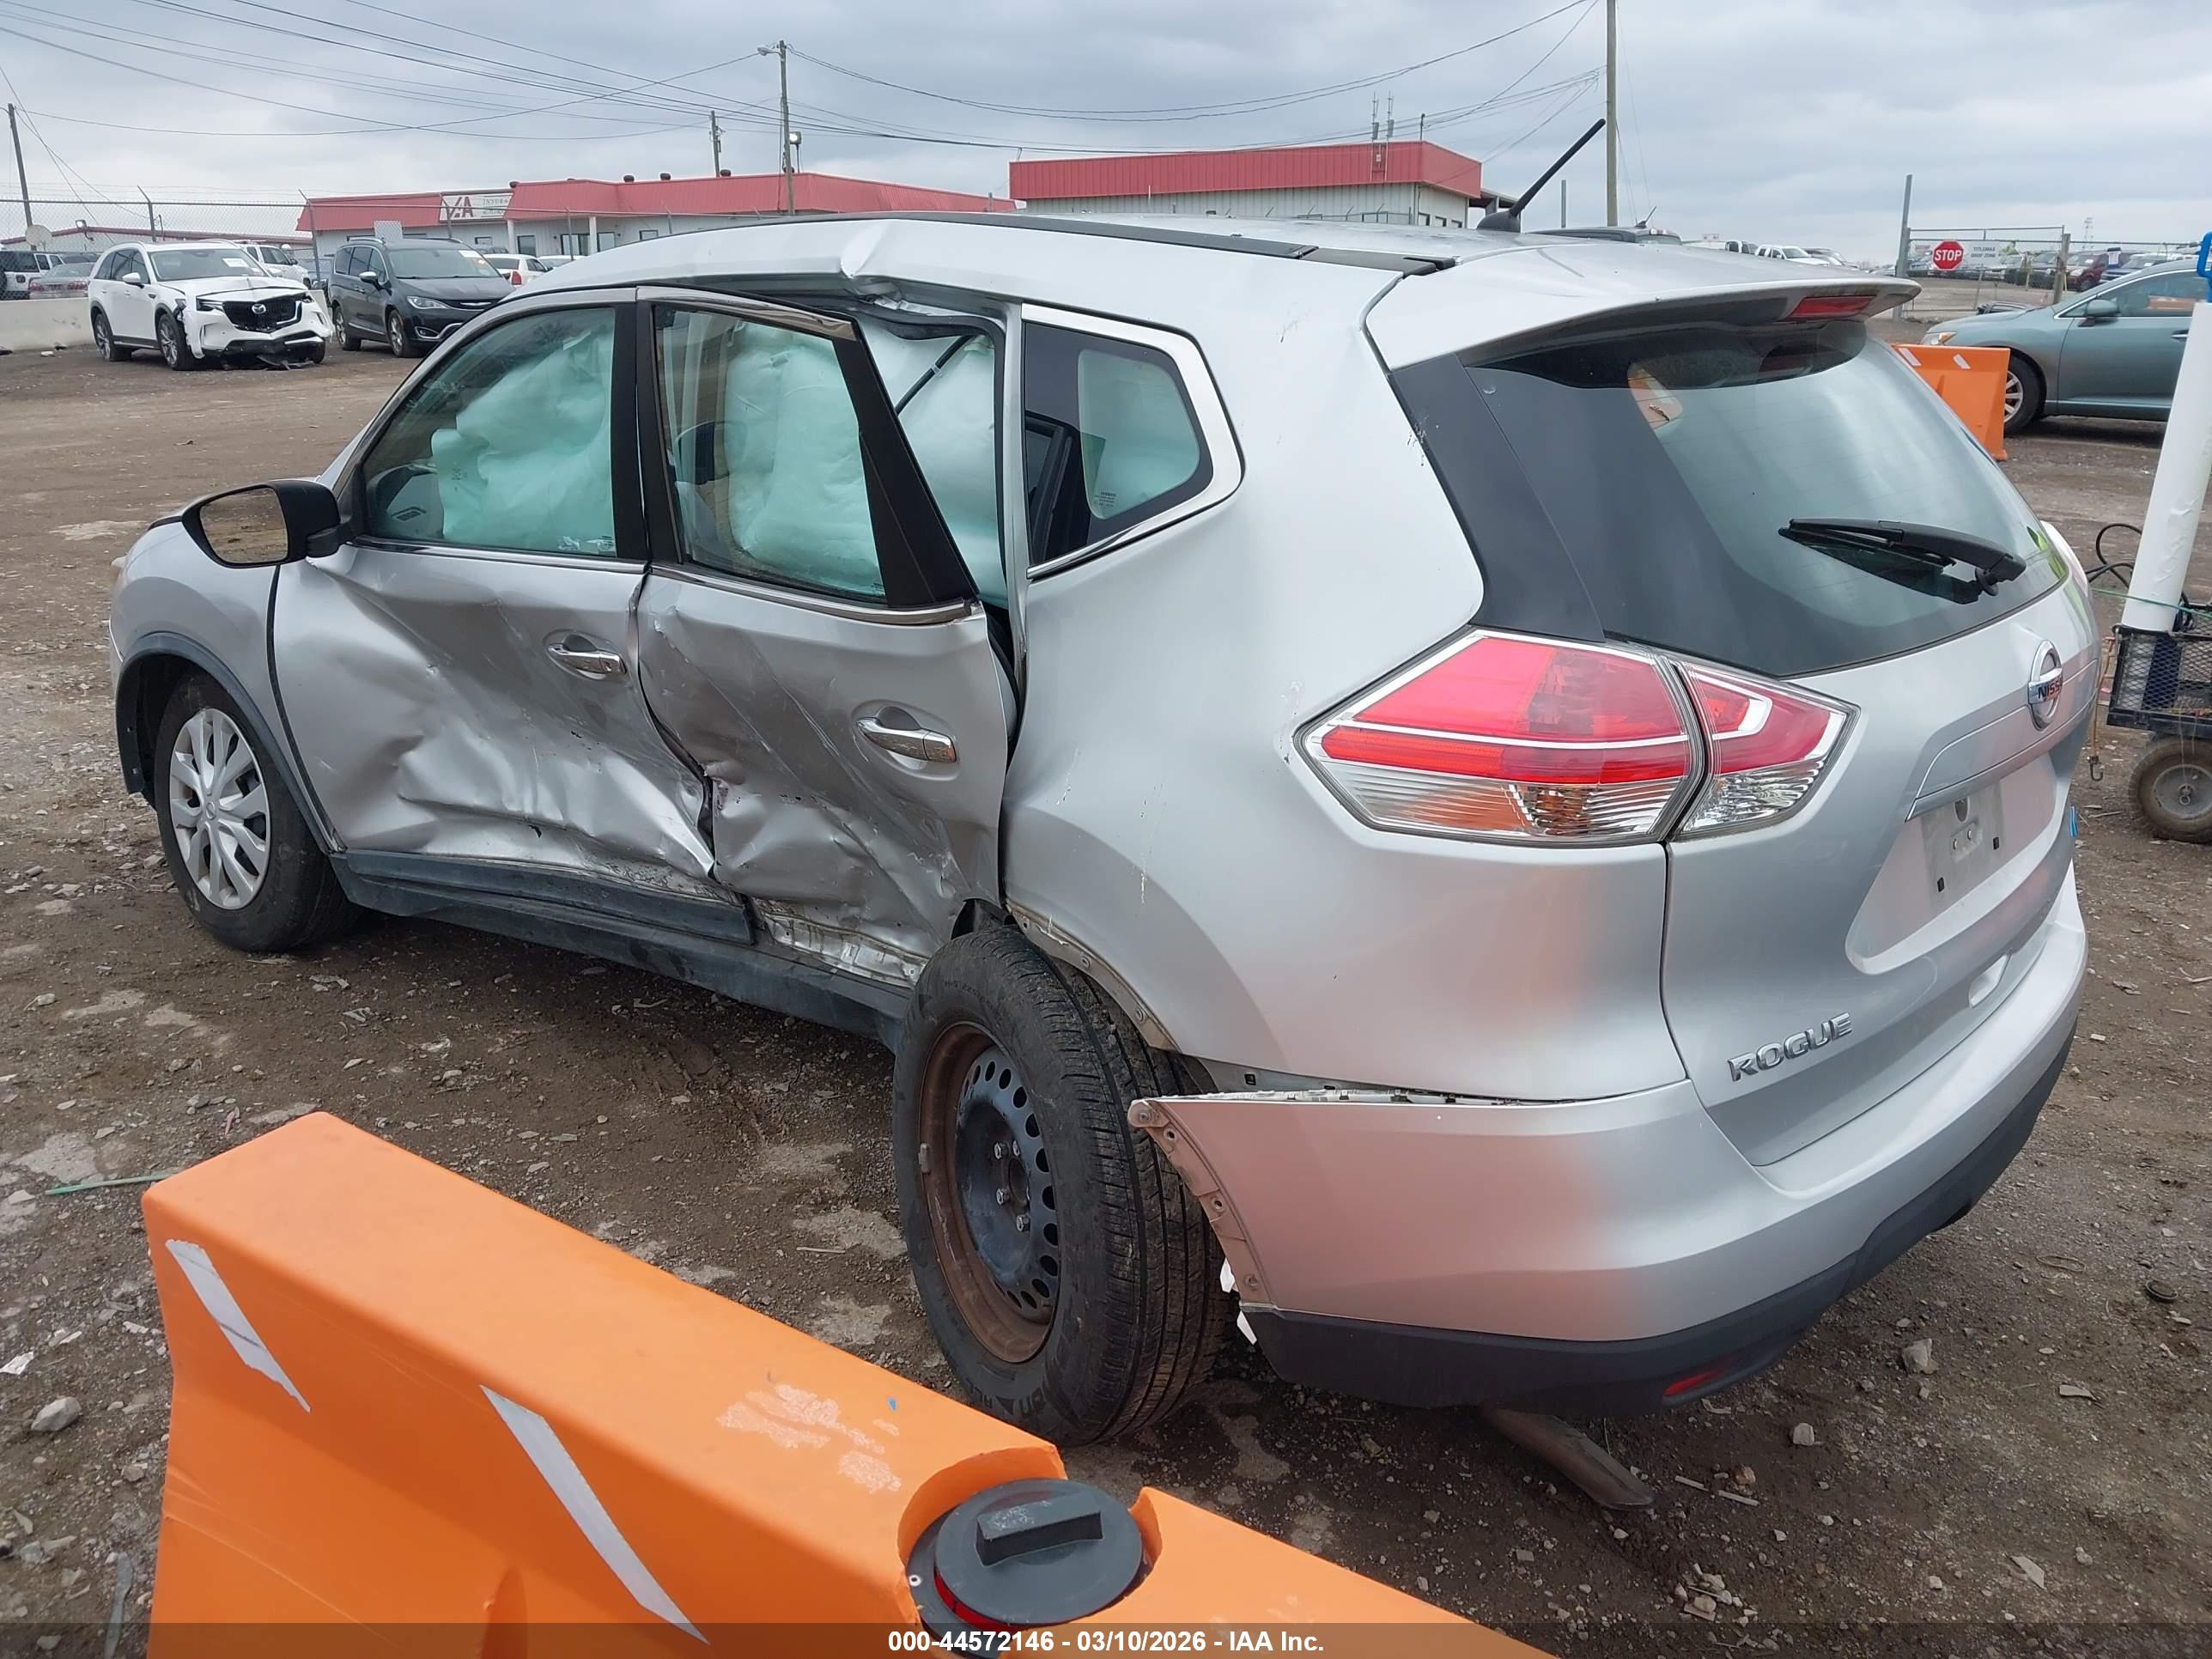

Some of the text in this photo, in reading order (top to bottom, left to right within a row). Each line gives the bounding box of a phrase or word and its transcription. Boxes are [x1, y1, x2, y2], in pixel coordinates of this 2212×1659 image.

[1935, 249, 1962, 262] STOP
[2038, 676, 2062, 700] NISS
[1727, 1012, 1853, 1082] ROGUE
